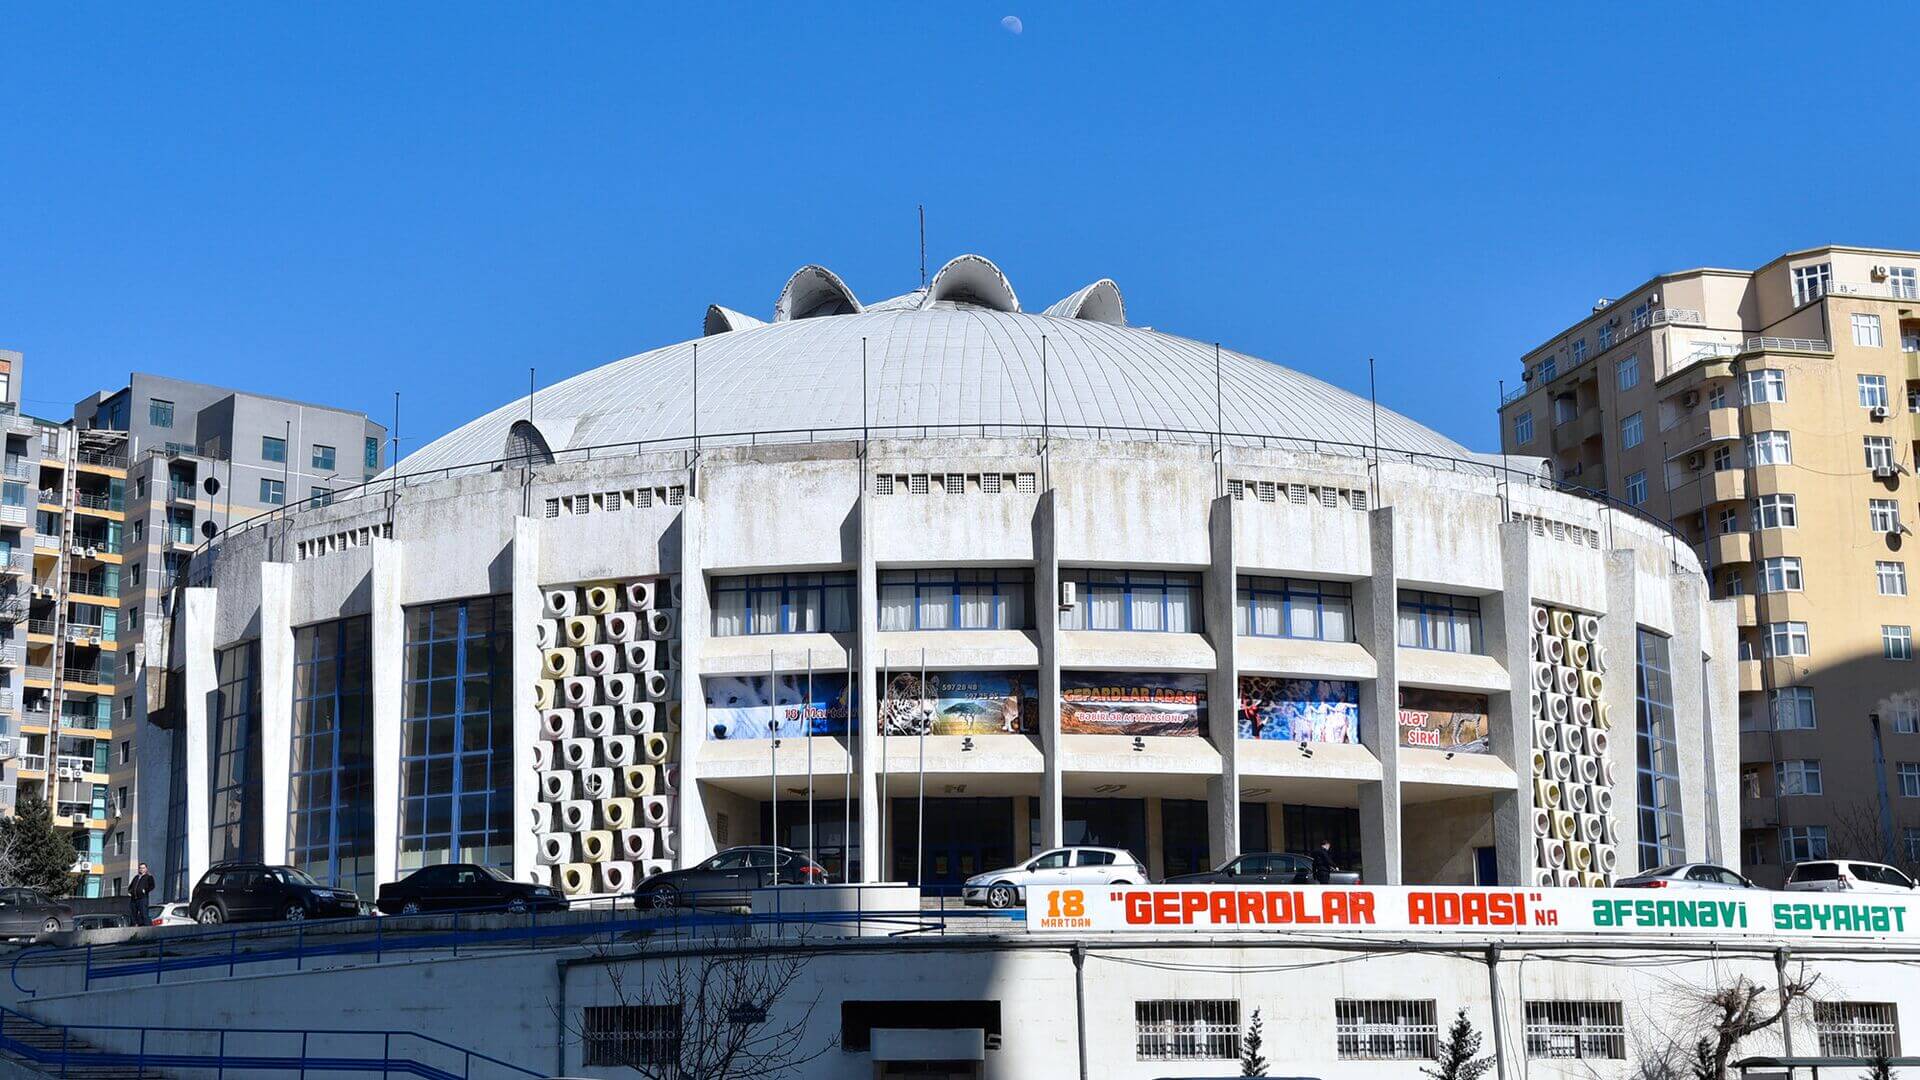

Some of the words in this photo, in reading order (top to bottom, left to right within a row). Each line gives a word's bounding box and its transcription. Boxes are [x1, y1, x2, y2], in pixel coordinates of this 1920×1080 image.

[1408, 728, 1440, 746] SİRKİ
[1047, 889, 1085, 917] 18
[1110, 891, 1376, 924] "GEPARDLAR
[1408, 892, 1542, 925] ADASI"
[1535, 909, 1558, 926] NA
[1041, 918, 1091, 928] MARTDAN
